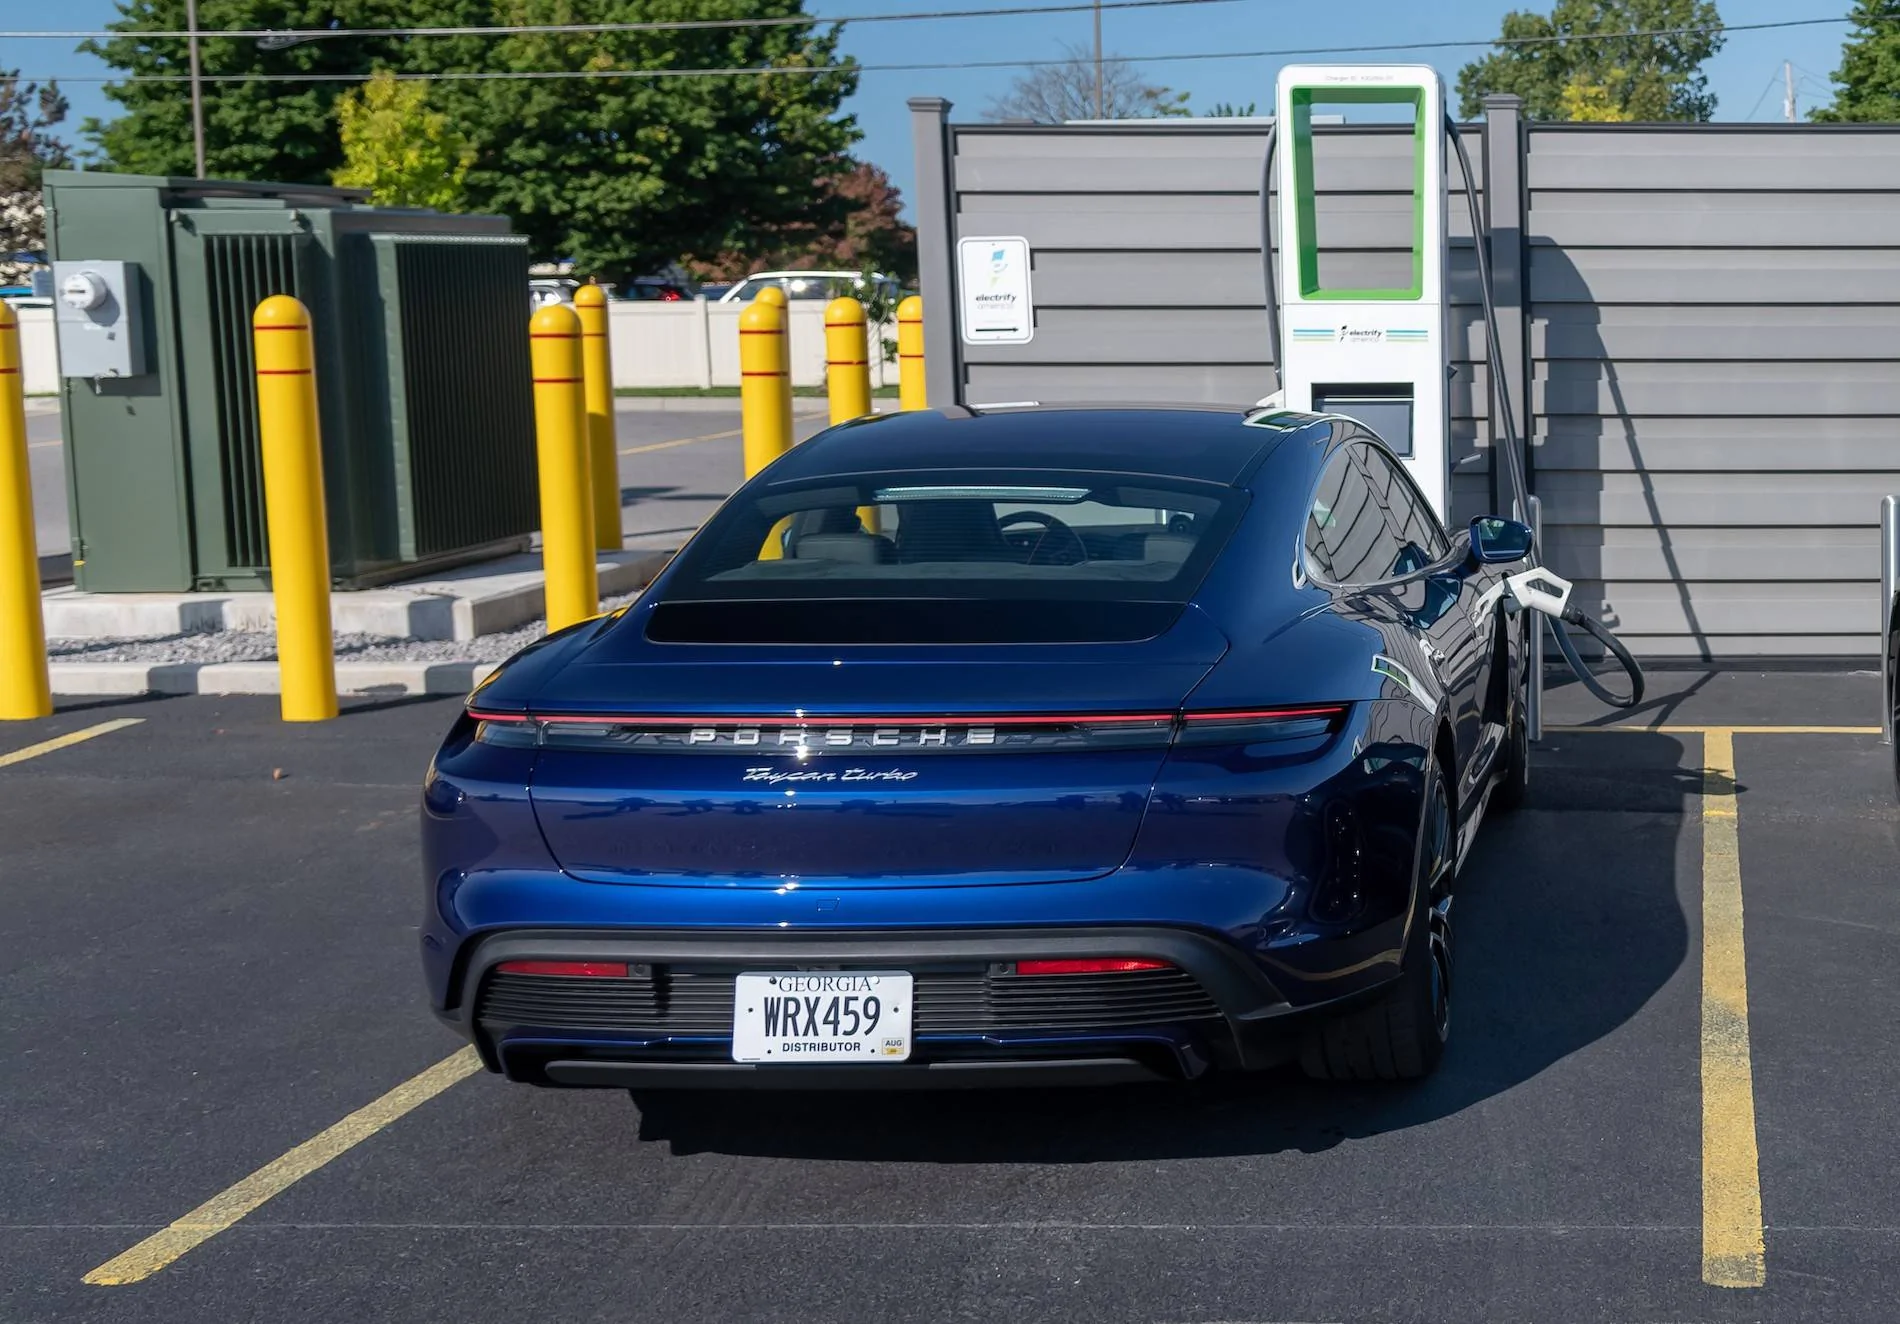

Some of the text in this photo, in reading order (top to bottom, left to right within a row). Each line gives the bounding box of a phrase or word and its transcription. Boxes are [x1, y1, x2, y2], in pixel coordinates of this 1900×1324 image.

[975, 293, 1017, 303] electrify
[1349, 329, 1382, 338] electrify
[689, 728, 996, 746] PORSCHE
[742, 766, 919, 785] Taycan turbo
[779, 976, 872, 992] GEORGIA
[764, 996, 881, 1037] WRX459
[782, 1042, 861, 1052] DISTRIBUTOR
[885, 1039, 902, 1047] AUG
